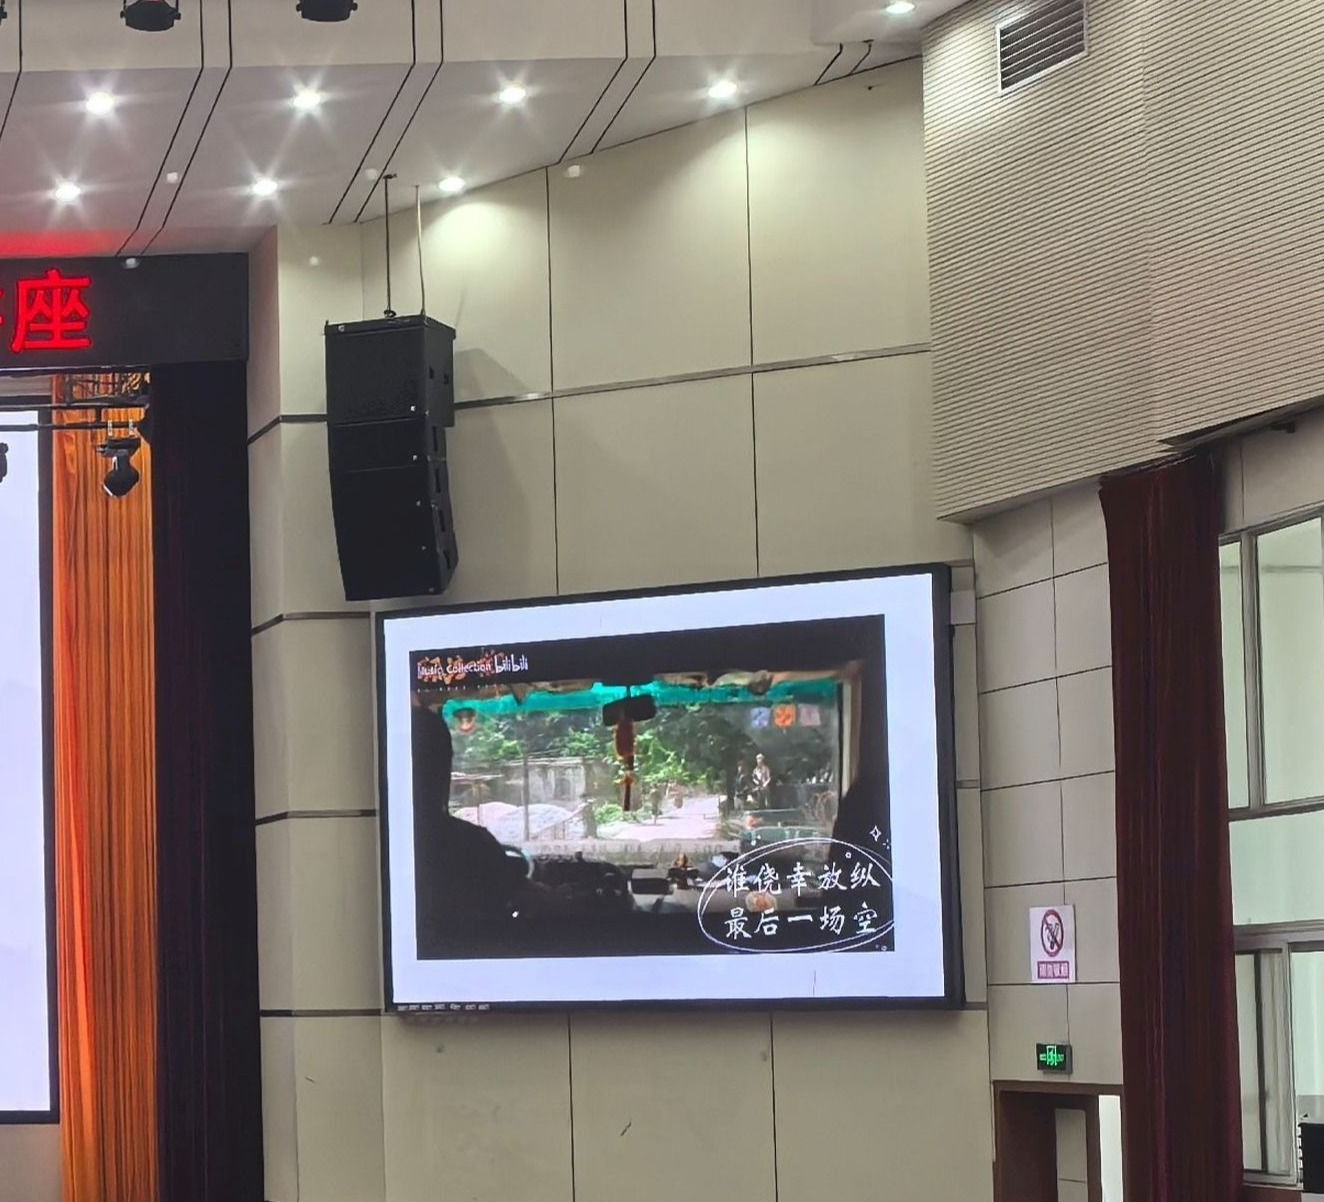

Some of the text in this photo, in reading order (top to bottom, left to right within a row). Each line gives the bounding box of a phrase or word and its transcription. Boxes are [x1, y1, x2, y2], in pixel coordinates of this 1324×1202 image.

[494, 653, 529, 674] bilibili
[723, 900, 880, 940] 最后一场空
